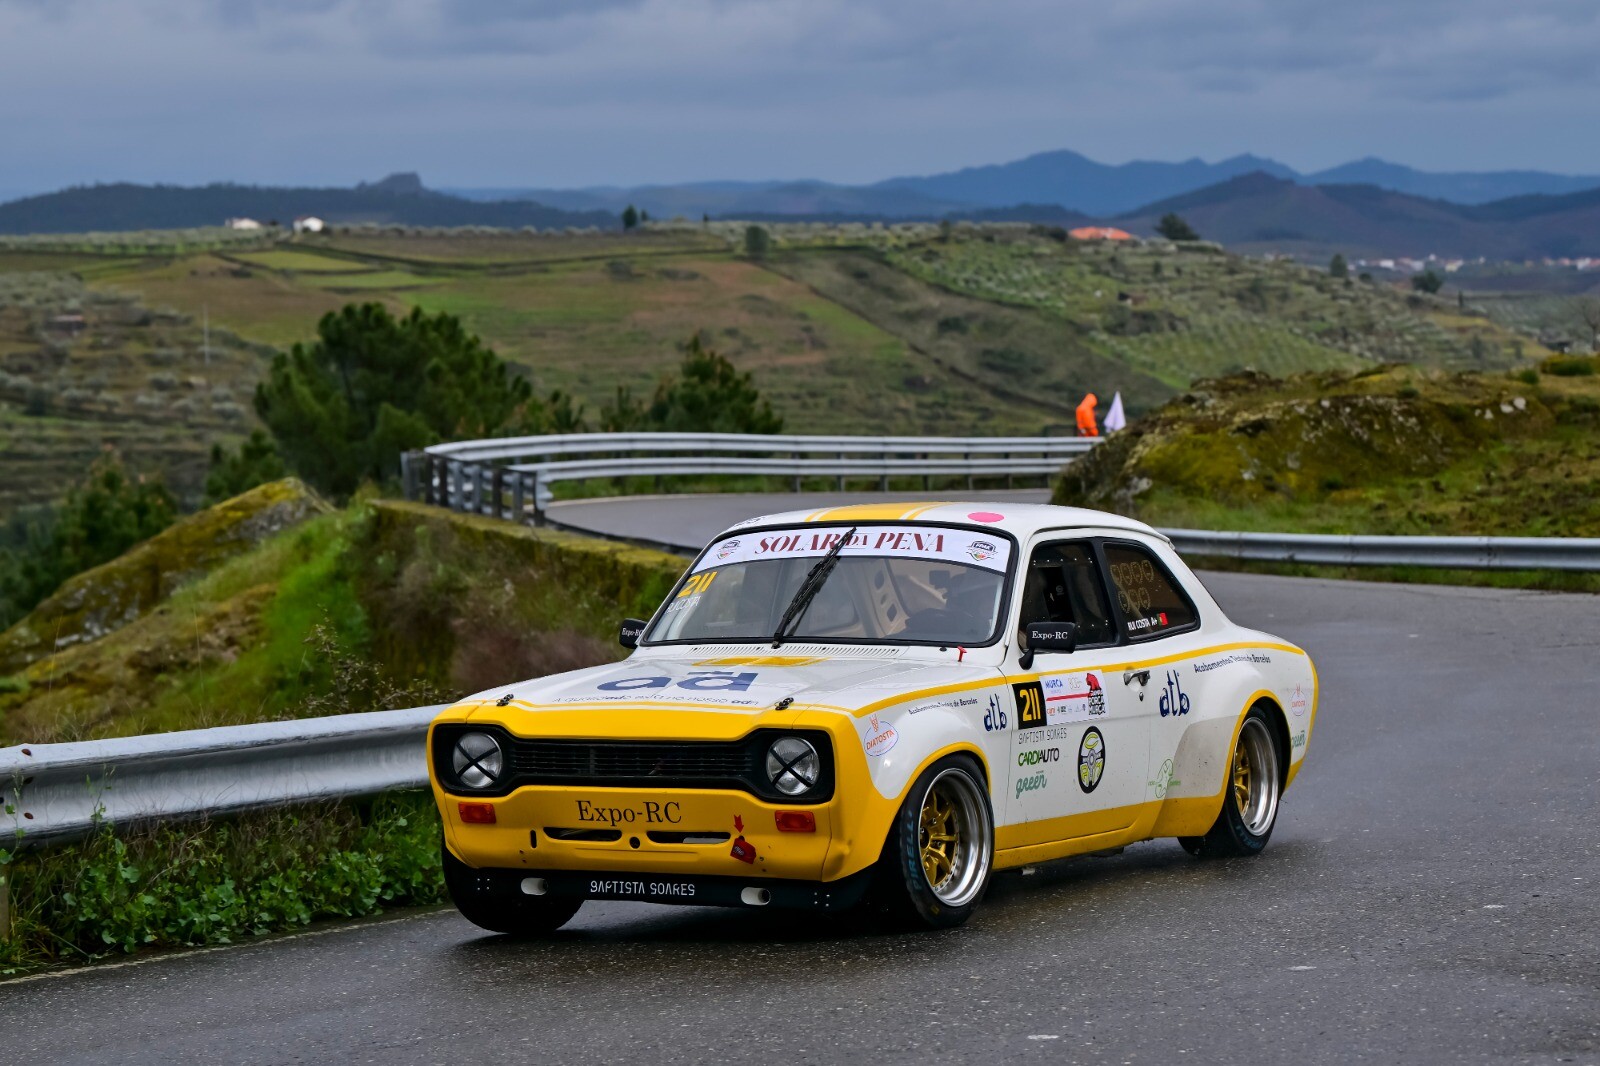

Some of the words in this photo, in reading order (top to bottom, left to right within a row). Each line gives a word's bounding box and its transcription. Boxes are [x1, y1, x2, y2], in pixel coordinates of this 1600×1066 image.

[755, 534, 841, 554] SOLAR
[874, 532, 944, 553] PENA
[677, 571, 717, 598] 211
[1136, 618, 1150, 629] COSTA
[1031, 630, 1068, 640] Expo-RC
[1020, 688, 1041, 721] 211
[1018, 748, 1060, 766] CARDIAUTO
[1016, 773, 1047, 800] green
[575, 800, 682, 827] Expo-RC
[590, 880, 646, 895] BAPTISTA
[650, 882, 696, 896] SOARES
